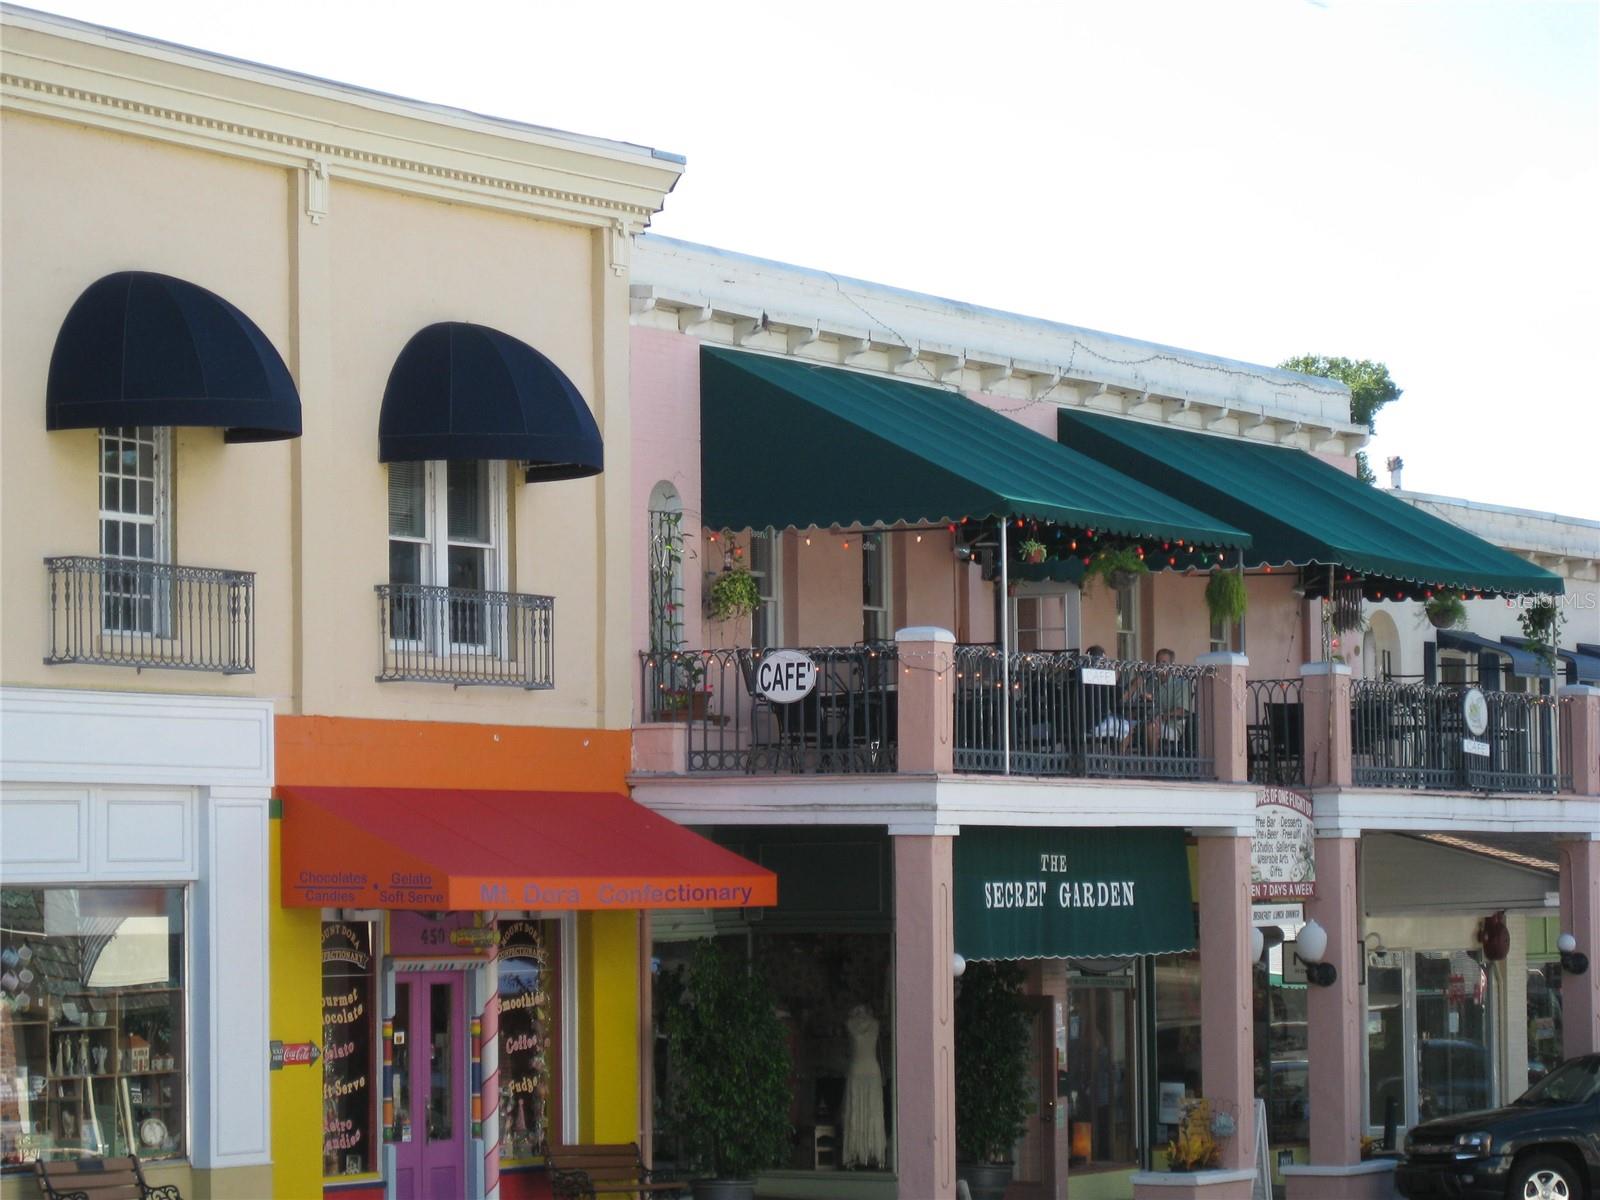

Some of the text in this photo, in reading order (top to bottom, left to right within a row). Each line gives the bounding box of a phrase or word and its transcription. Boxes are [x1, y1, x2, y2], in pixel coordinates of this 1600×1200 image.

[1280, 815, 1303, 828] Desserts
[1040, 854, 1067, 873] THE
[299, 871, 368, 884] Chocolates
[391, 872, 433, 885] Gelato
[304, 889, 356, 902] Candies
[379, 890, 445, 904] Soft Serve
[479, 884, 753, 905] Mt. Dora Confectionary
[984, 881, 1135, 909] SECRET GARDEN
[1251, 883, 1314, 897] EN 7 DAYS A WEEK
[321, 923, 341, 944] OUNT
[421, 927, 445, 945] 450
[321, 987, 359, 1008] ourmet
[322, 1003, 363, 1025] ocolate
[335, 1076, 366, 1097] Serve
